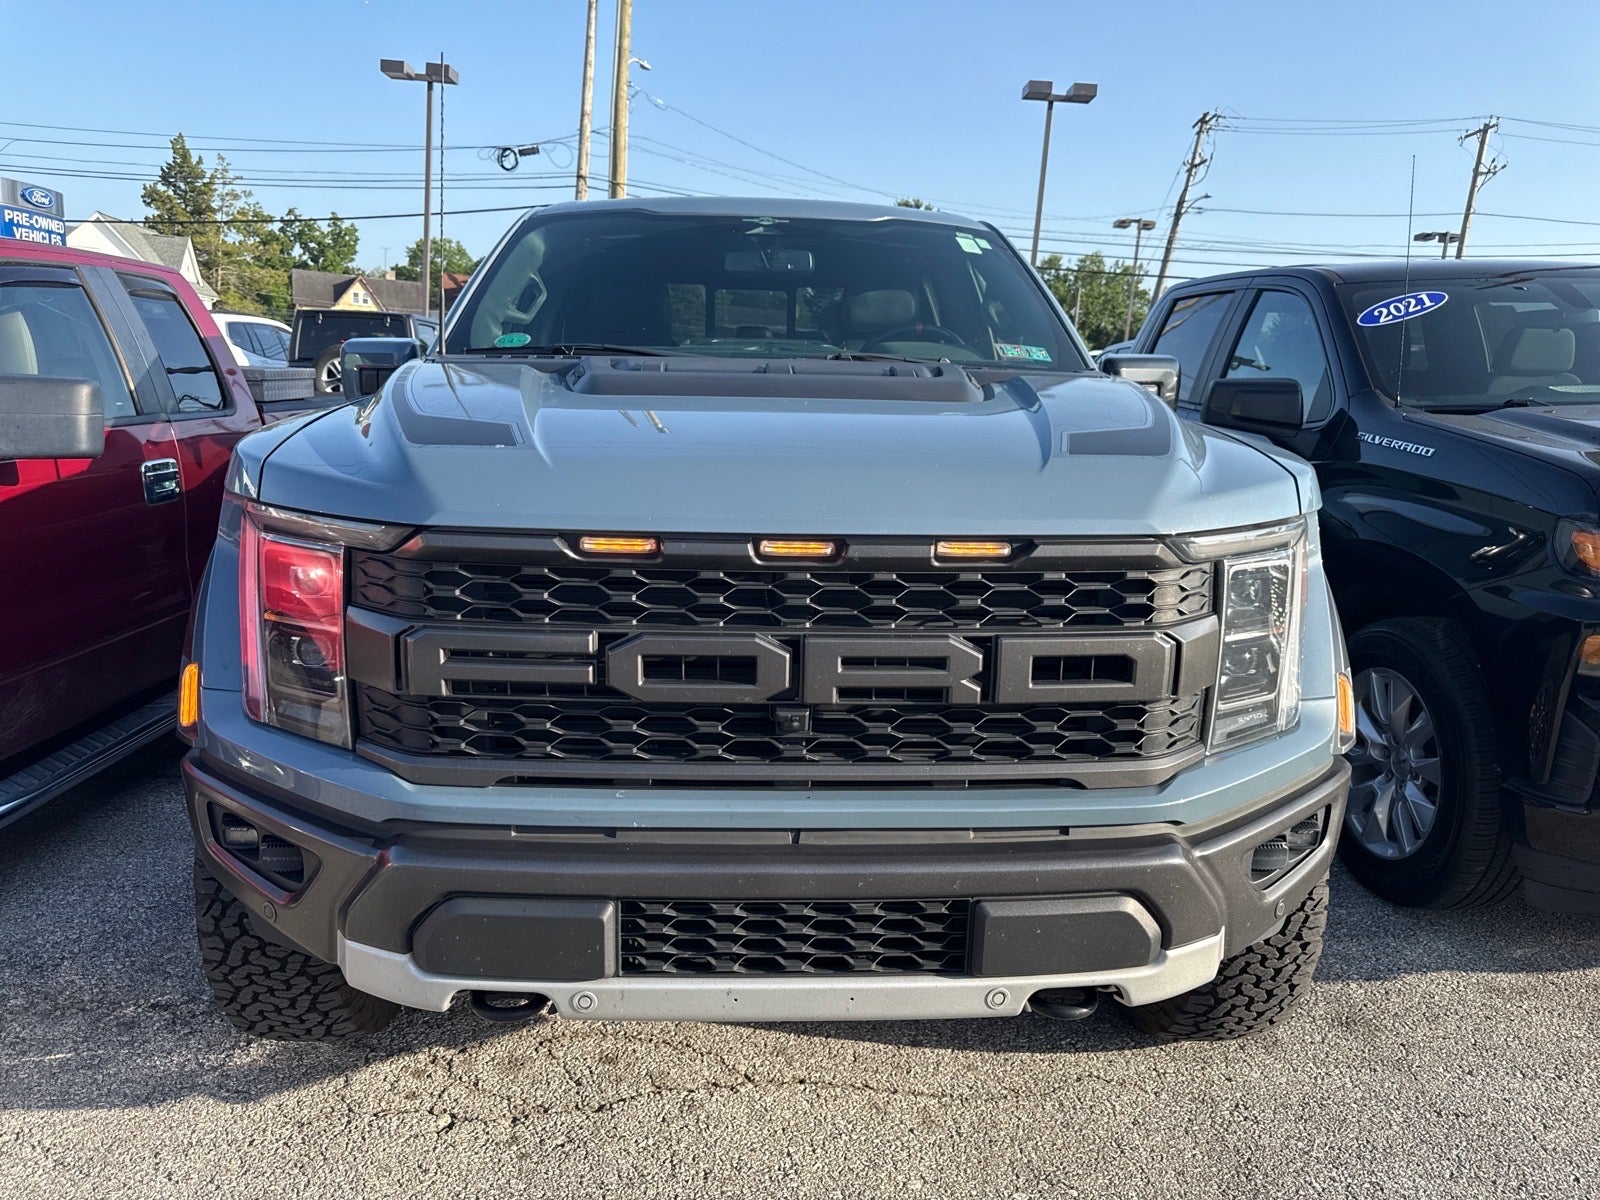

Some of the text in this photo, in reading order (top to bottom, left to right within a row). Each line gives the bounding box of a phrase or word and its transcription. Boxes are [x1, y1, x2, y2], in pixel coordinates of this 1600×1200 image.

[31, 190, 50, 204] Ford
[4, 209, 65, 234] PRE-OWNED
[1373, 293, 1436, 323] 2021
[1355, 431, 1436, 457] SILVERADO
[404, 628, 1175, 706] FORD
